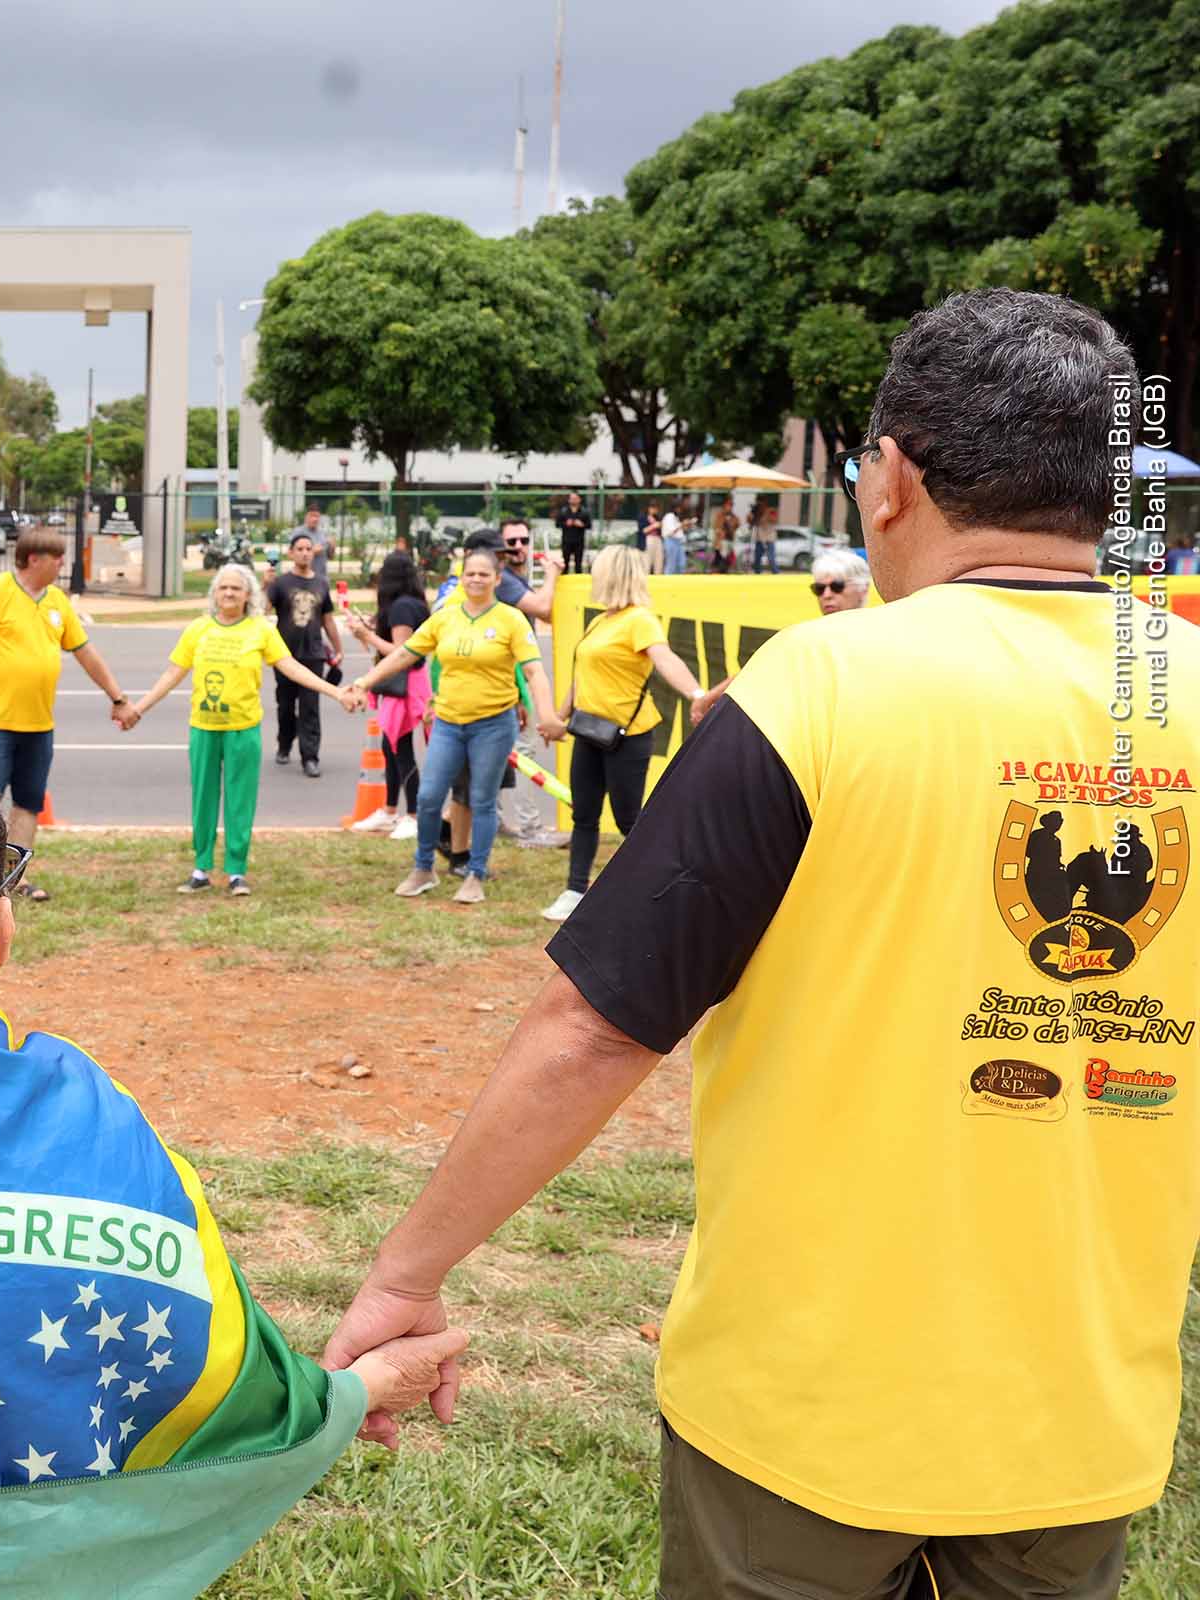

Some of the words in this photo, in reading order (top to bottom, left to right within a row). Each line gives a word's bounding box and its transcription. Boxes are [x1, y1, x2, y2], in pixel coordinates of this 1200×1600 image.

[980, 987, 1065, 1017] Santo
[961, 1014, 1028, 1041] Salto
[1033, 1019, 1069, 1044] da
[1087, 1081, 1169, 1100] Serigrafia
